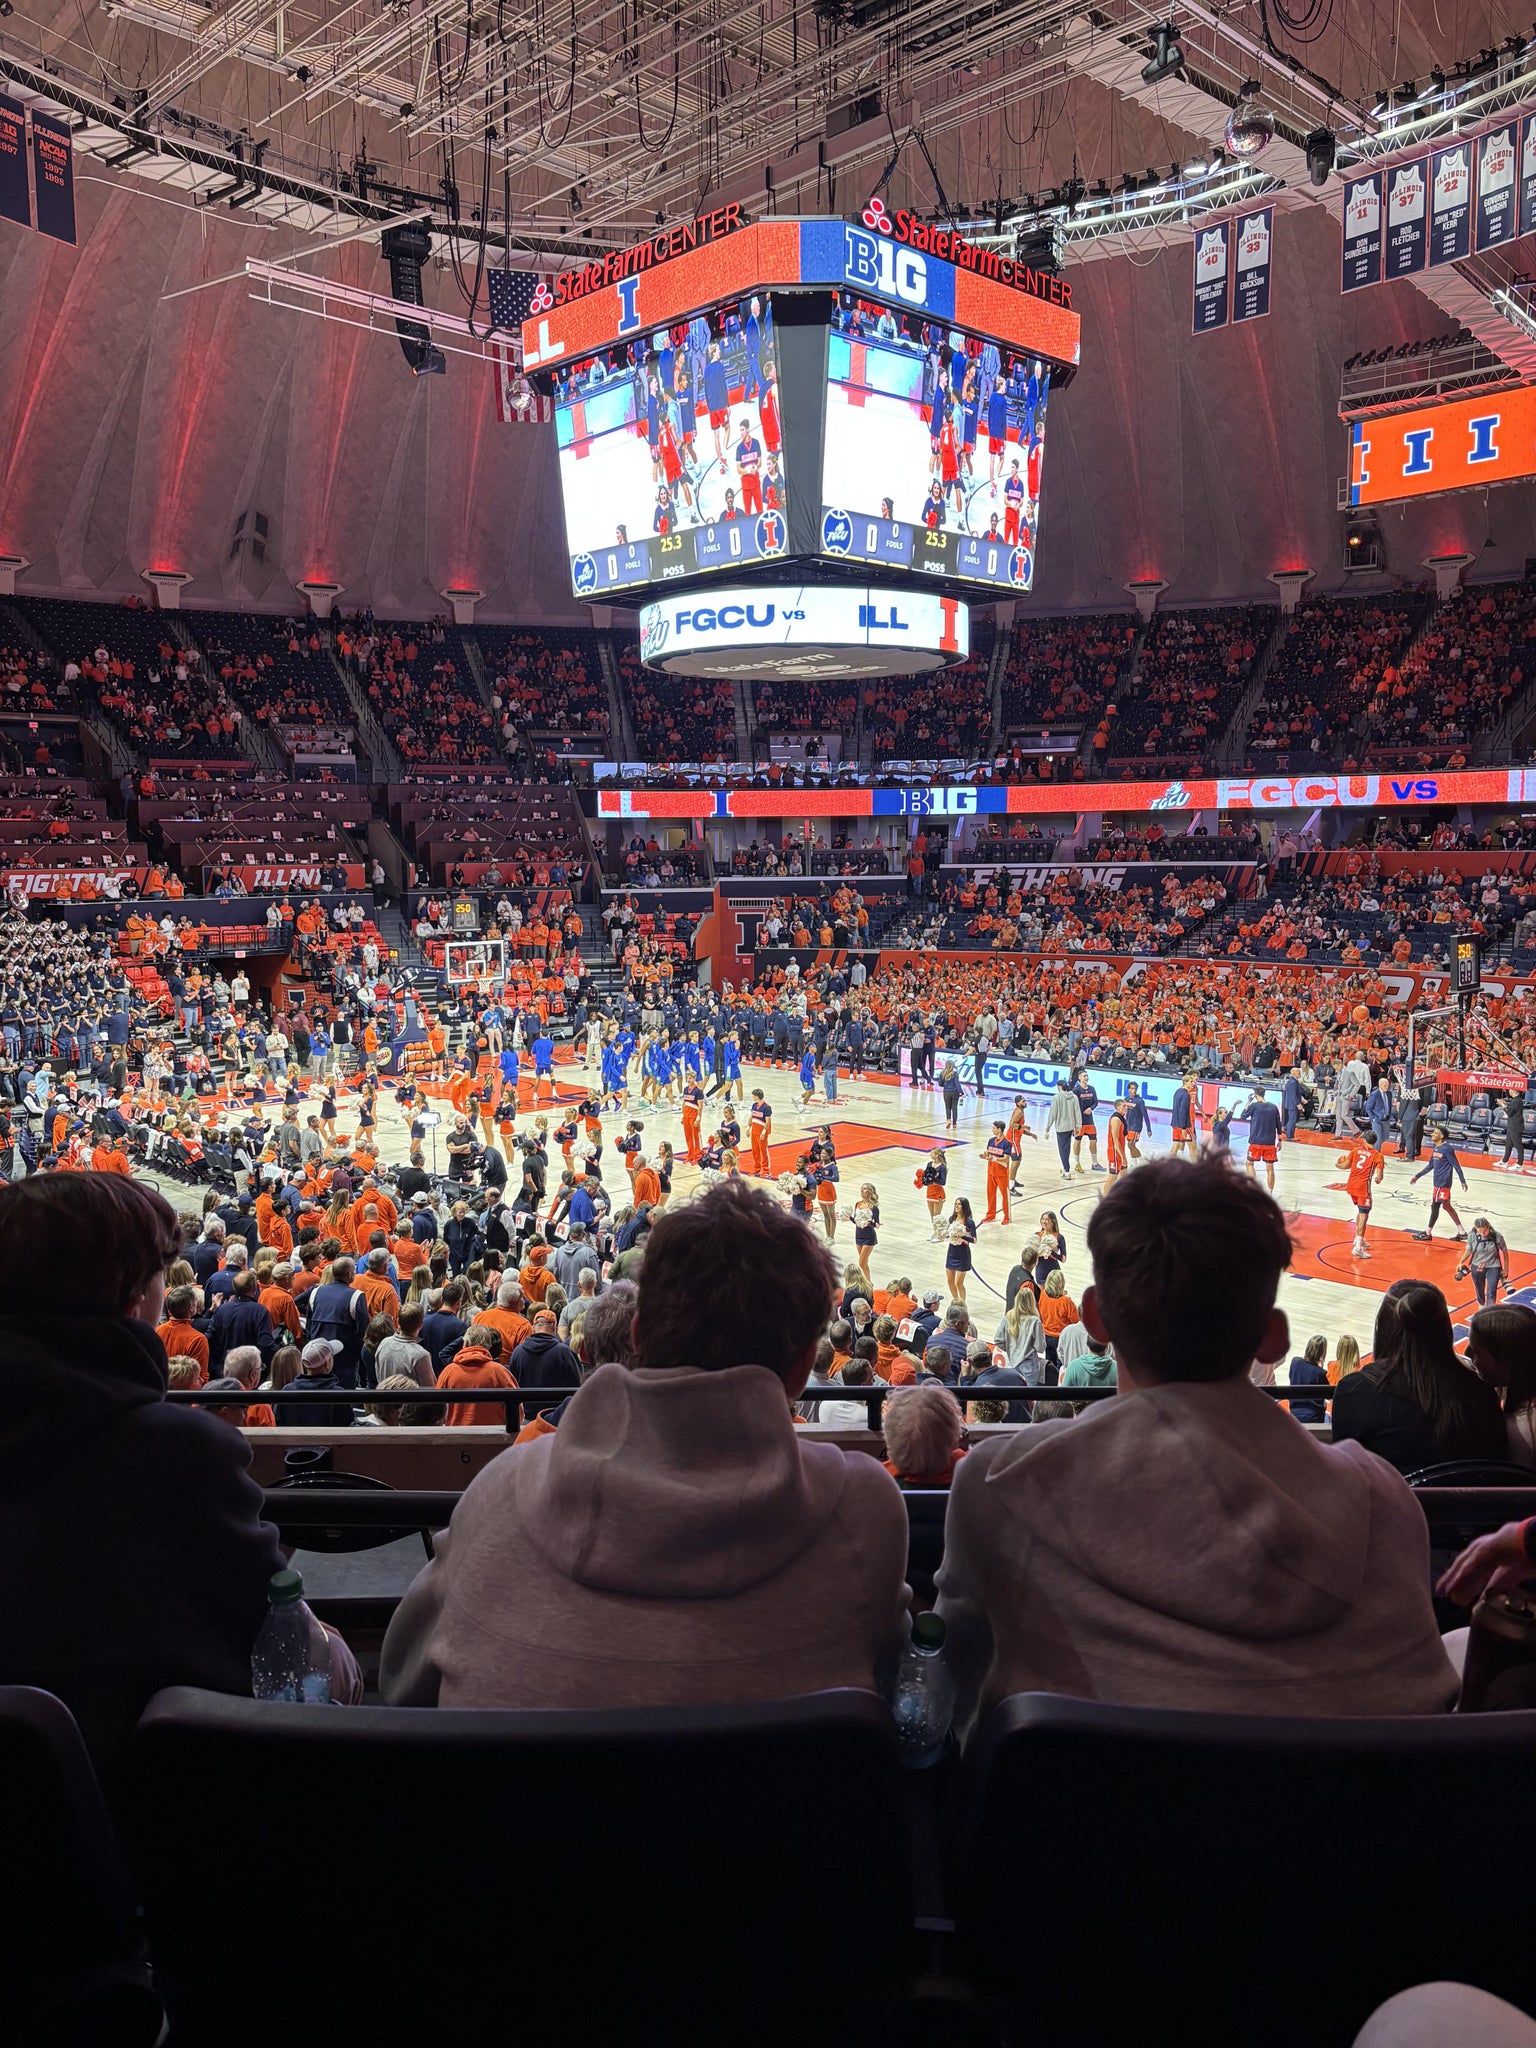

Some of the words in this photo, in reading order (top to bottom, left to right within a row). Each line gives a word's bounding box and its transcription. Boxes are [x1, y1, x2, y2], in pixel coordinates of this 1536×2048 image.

[40, 140, 67, 160] NCAA
[1483, 149, 1512, 169] ILLINOIS
[44, 161, 63, 175] 1997
[1490, 160, 1505, 175] 35
[1437, 168, 1466, 187] ILLINOIS
[1392, 184, 1423, 201] ILLINOIS
[1444, 179, 1458, 193] 22
[1349, 198, 1377, 215] ILLINOIS
[1399, 194, 1415, 208] 37
[1357, 207, 1368, 220] 11
[1434, 213, 1448, 226] JOHN
[654, 202, 743, 261] CENTER
[1442, 219, 1458, 231] KERR
[1246, 241, 1260, 253] 33
[1392, 231, 1420, 247] FLETCHER
[1205, 254, 1218, 266] 40
[1001, 258, 1073, 308] CENTER
[1240, 277, 1264, 290] ERICKSON
[617, 274, 640, 334] I
[1402, 427, 1434, 477] I
[1467, 414, 1501, 464] I
[707, 528, 715, 543] 0
[763, 519, 779, 549] I
[866, 524, 878, 553] 0
[892, 523, 899, 538] 0
[660, 535, 682, 552] 25.3
[729, 527, 741, 556] 0
[886, 539, 904, 550] FOULS
[925, 531, 947, 548] 25.3
[629, 544, 635, 559] 0
[703, 543, 721, 553] FOULS
[970, 541, 977, 555] 0
[607, 554, 618, 581] 0
[625, 560, 641, 570] FOULS
[924, 561, 945, 573] POSS
[964, 554, 980, 565] FOULS
[987, 549, 998, 576] 0
[1015, 554, 1027, 581] I
[663, 564, 685, 578] POSS
[675, 604, 775, 634] FGCU
[858, 604, 909, 630] ILL
[939, 597, 959, 652] I
[1150, 792, 1191, 810] FGCU
[1217, 774, 1380, 808] FGCU
[710, 790, 734, 818] I
[984, 1062, 1059, 1087] FGCU
[1356, 1154, 1366, 1169] 2
[461, 1451, 470, 1464] 6
